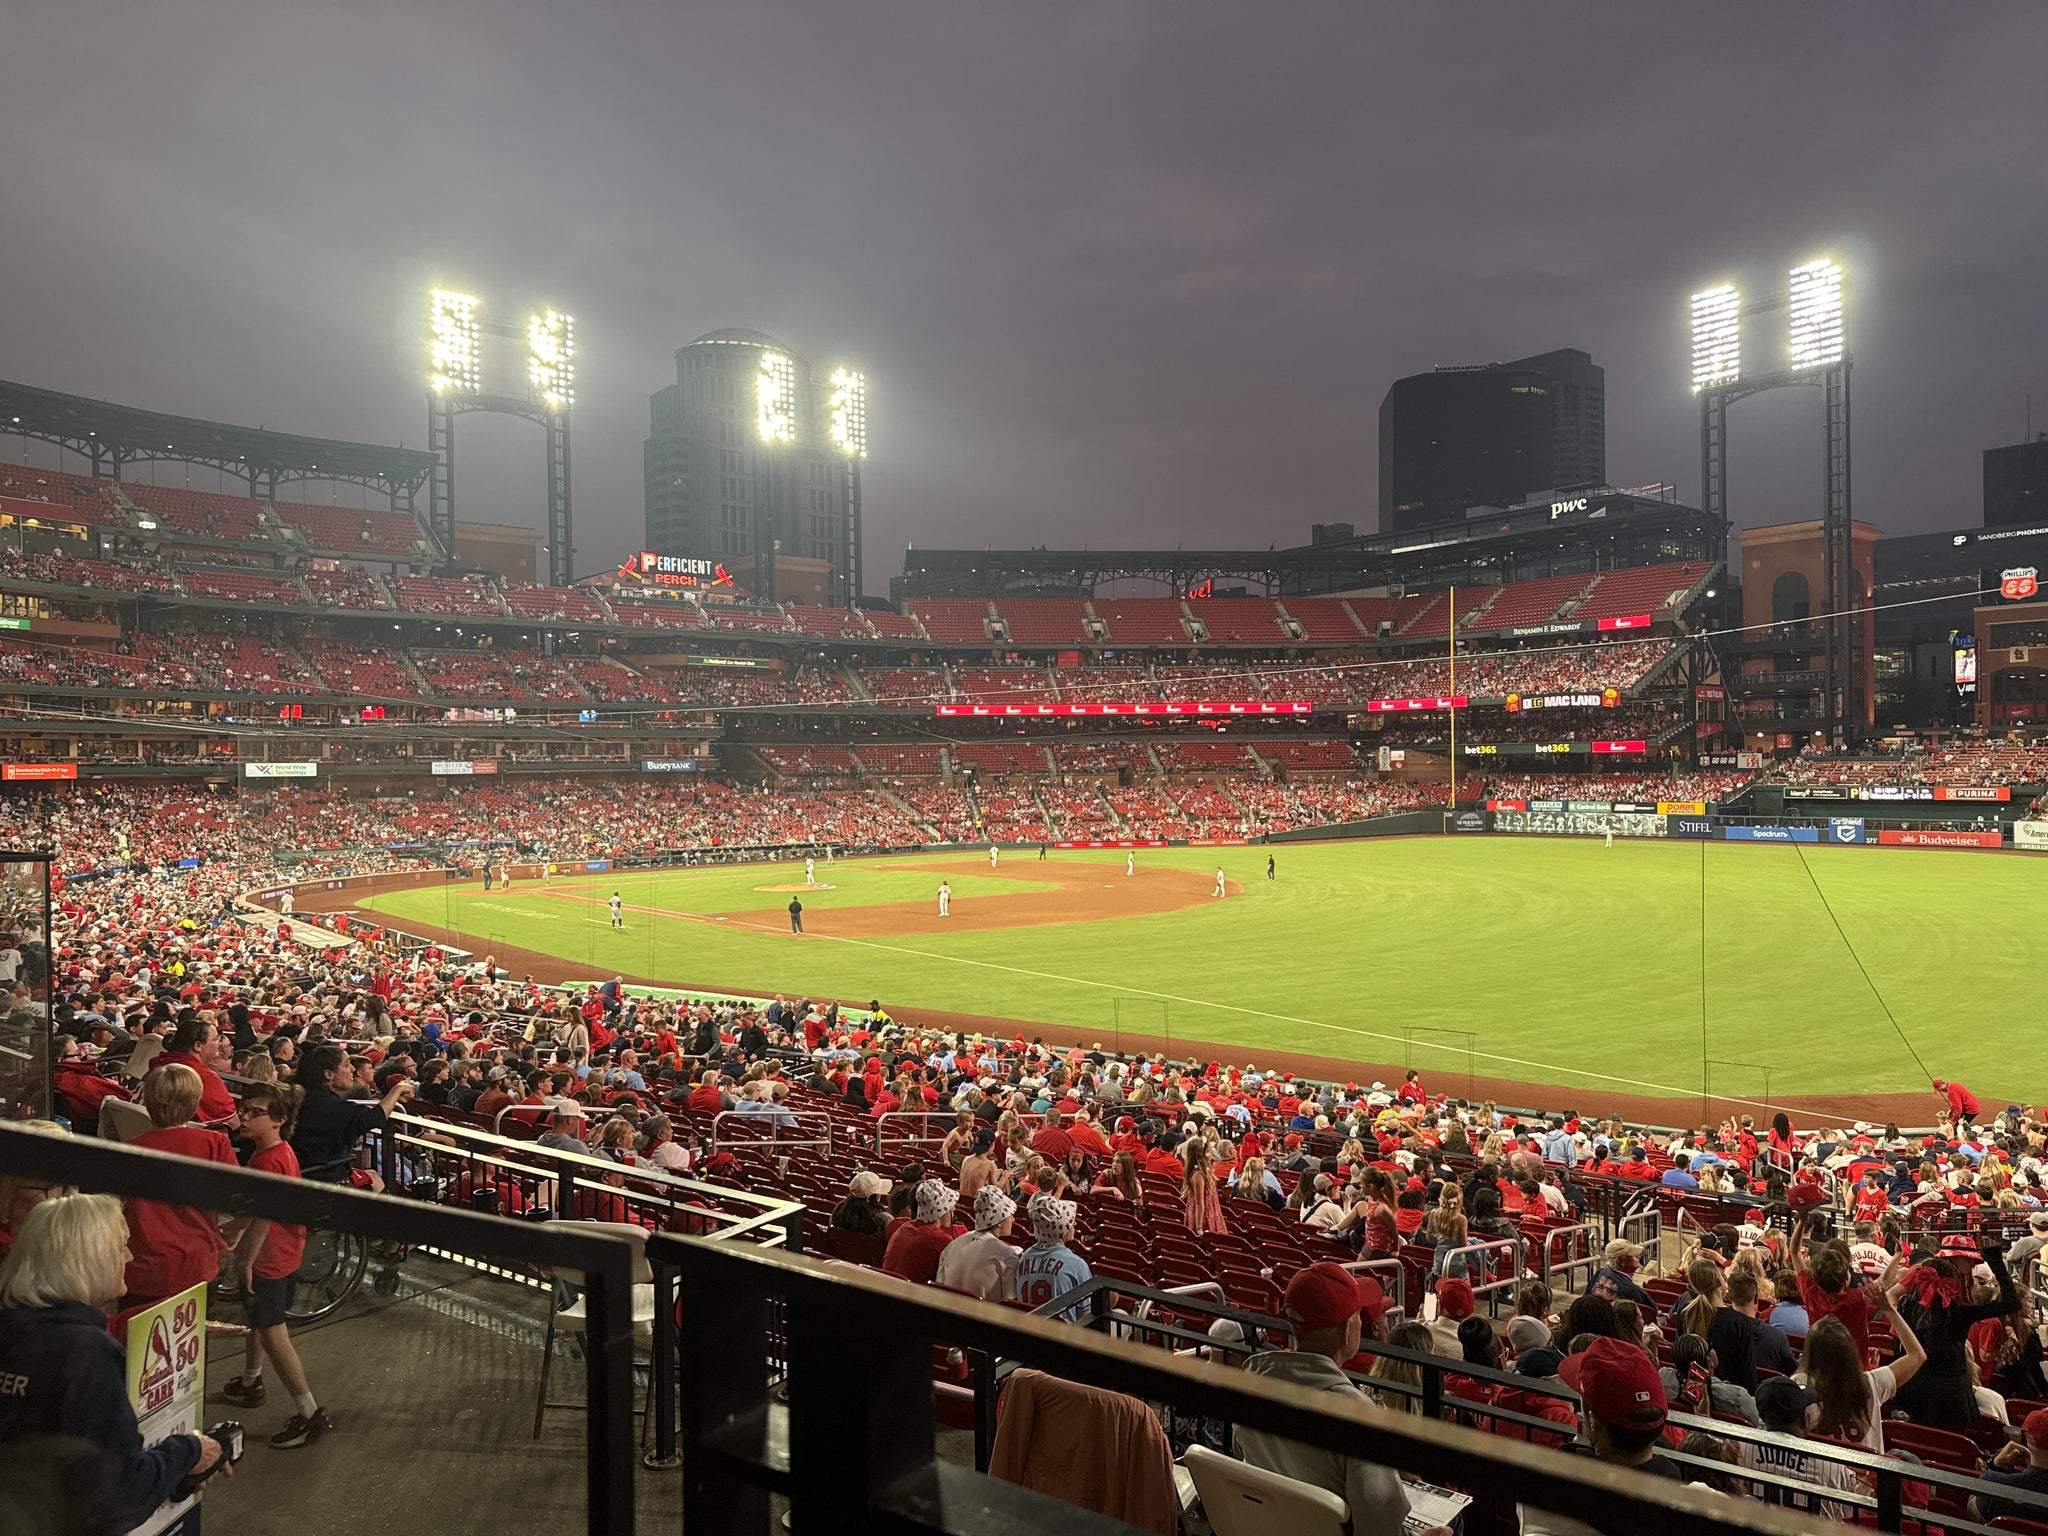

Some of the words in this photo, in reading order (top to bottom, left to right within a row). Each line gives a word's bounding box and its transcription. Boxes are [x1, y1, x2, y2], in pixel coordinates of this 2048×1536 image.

[1550, 498, 1587, 519] pwc
[640, 552, 712, 575] PERFICIENT
[655, 573, 697, 586] PERCH
[2004, 569, 2034, 578] PHILLIPS
[2005, 579, 2033, 594] 66
[1513, 626, 1543, 636] BENJAMIN
[1544, 695, 1571, 707] MAC
[1571, 695, 1600, 706] LAND
[1465, 746, 1497, 755] bet365
[1535, 744, 1570, 753] bet365
[1957, 790, 1995, 798] PURINA
[1679, 821, 1712, 833] STIFEL
[1831, 817, 1862, 826] CarShield
[1753, 829, 1785, 839] Spectrum
[1851, 1251, 1885, 1264] PUJOLS
[173, 1298, 197, 1334] 50
[175, 1335, 199, 1372] 50
[146, 1379, 174, 1411] CARE
[1756, 1444, 1808, 1474] JUDGE
